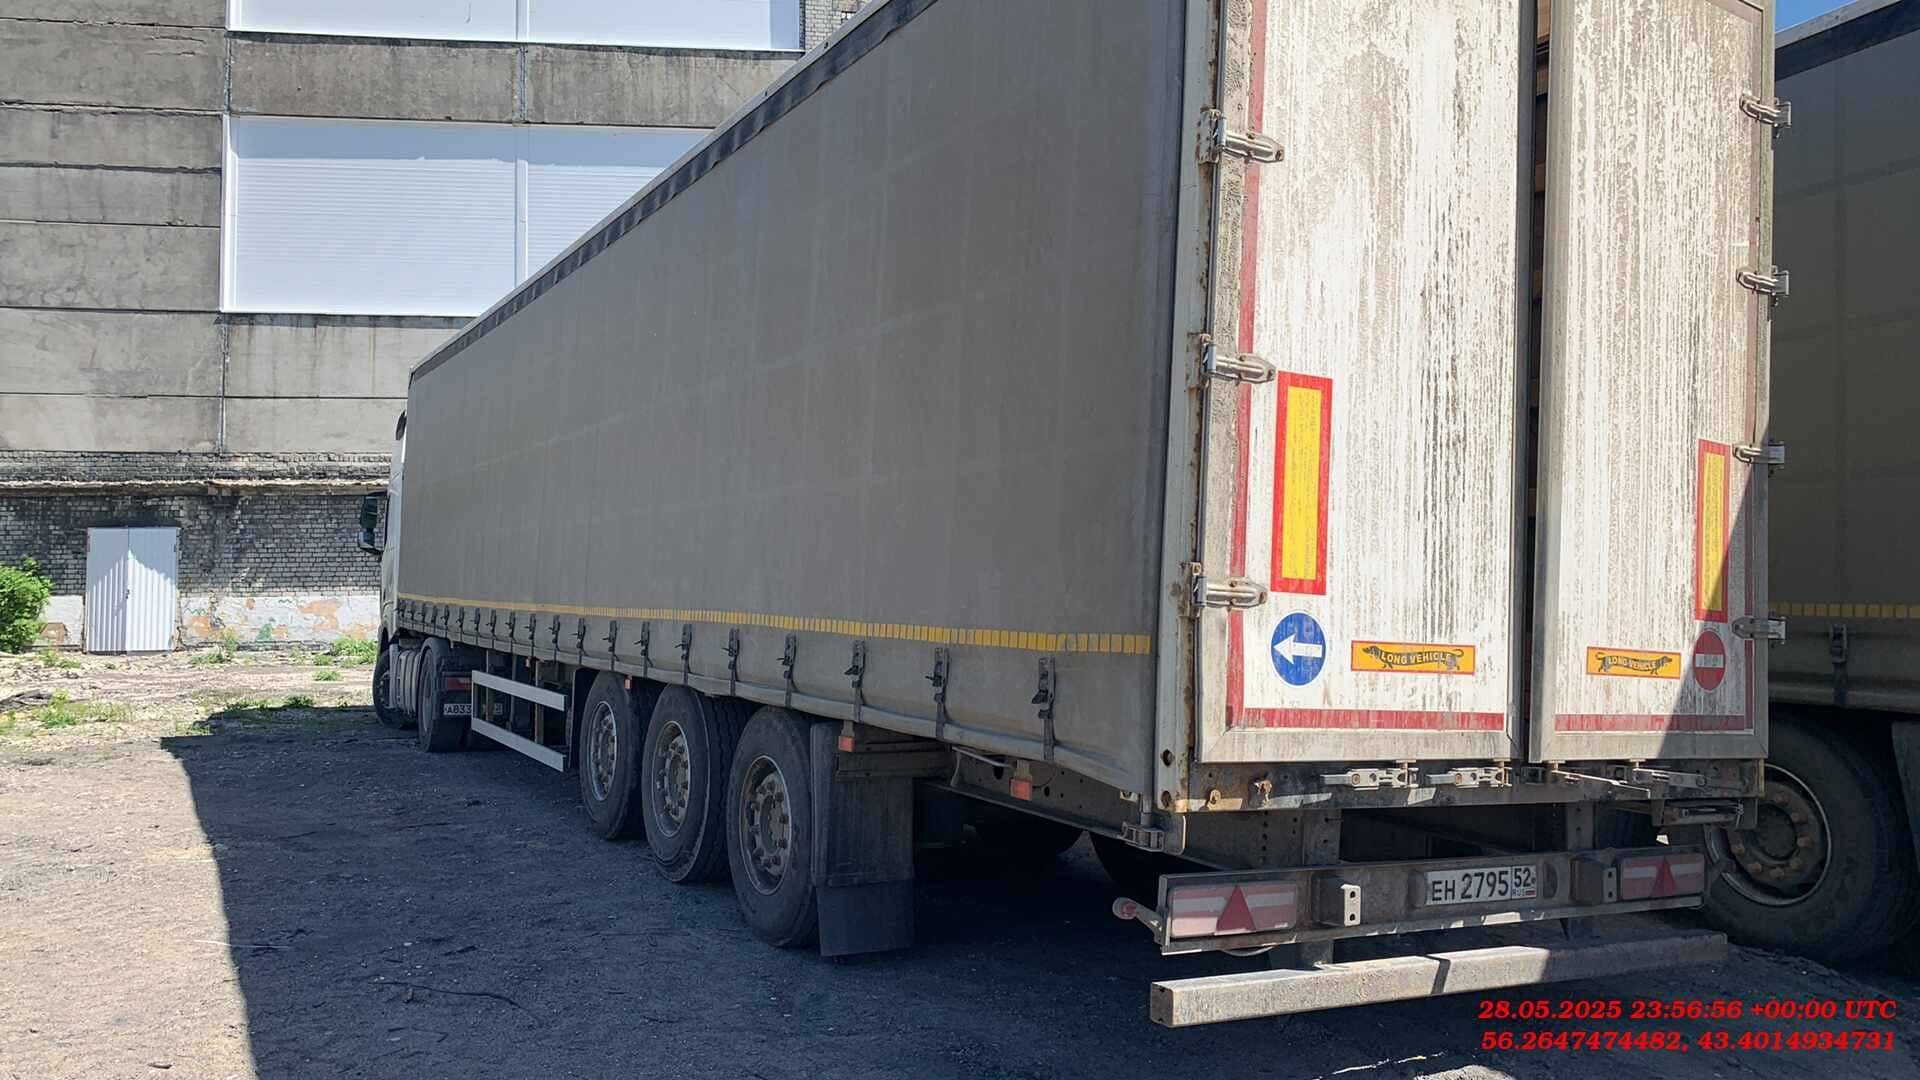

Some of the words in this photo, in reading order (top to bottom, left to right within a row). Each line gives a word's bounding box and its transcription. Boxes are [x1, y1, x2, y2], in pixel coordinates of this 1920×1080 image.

[1381, 652, 1408, 664] LONG
[1409, 651, 1451, 664] VEHICLE
[1460, 871, 1509, 899] 2795
[1513, 867, 1531, 888] 52
